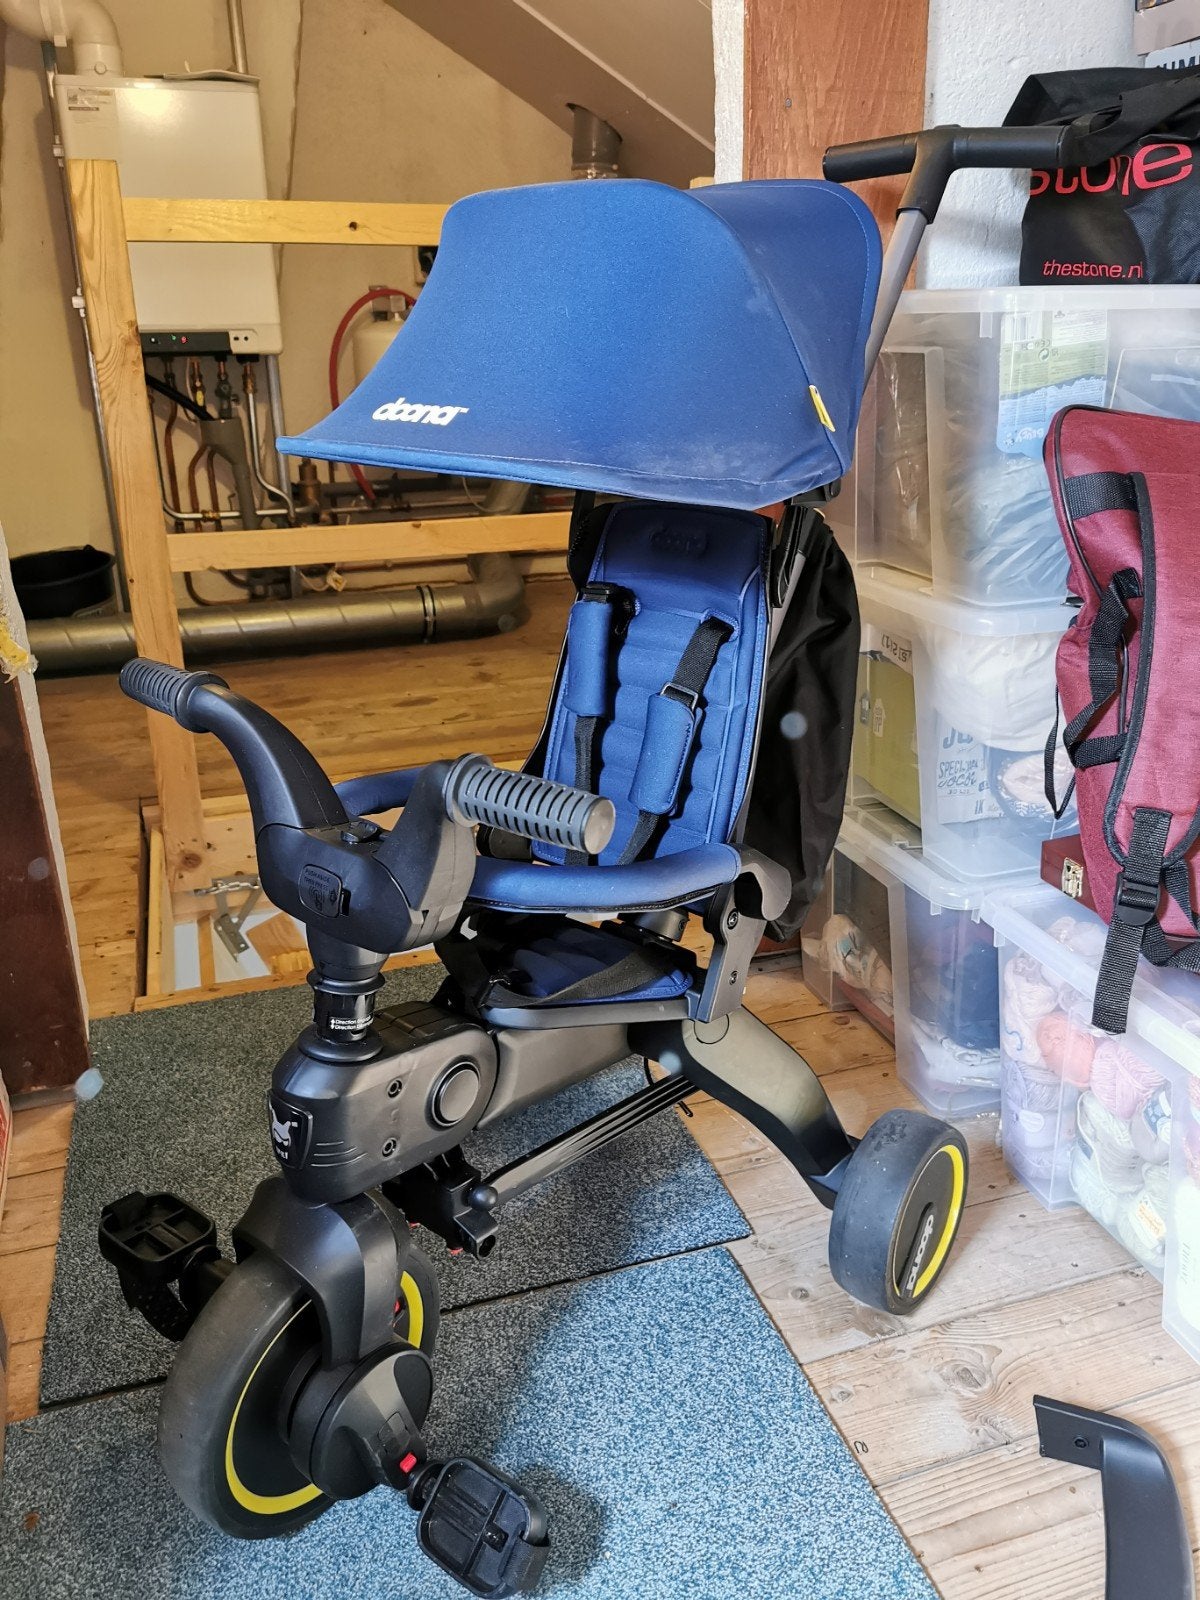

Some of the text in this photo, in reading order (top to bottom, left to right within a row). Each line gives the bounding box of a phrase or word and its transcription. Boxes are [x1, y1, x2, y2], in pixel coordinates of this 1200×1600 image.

[1043, 259, 1143, 279] thestone.nl
[372, 397, 469, 426] doona
[905, 1214, 934, 1291] doona
